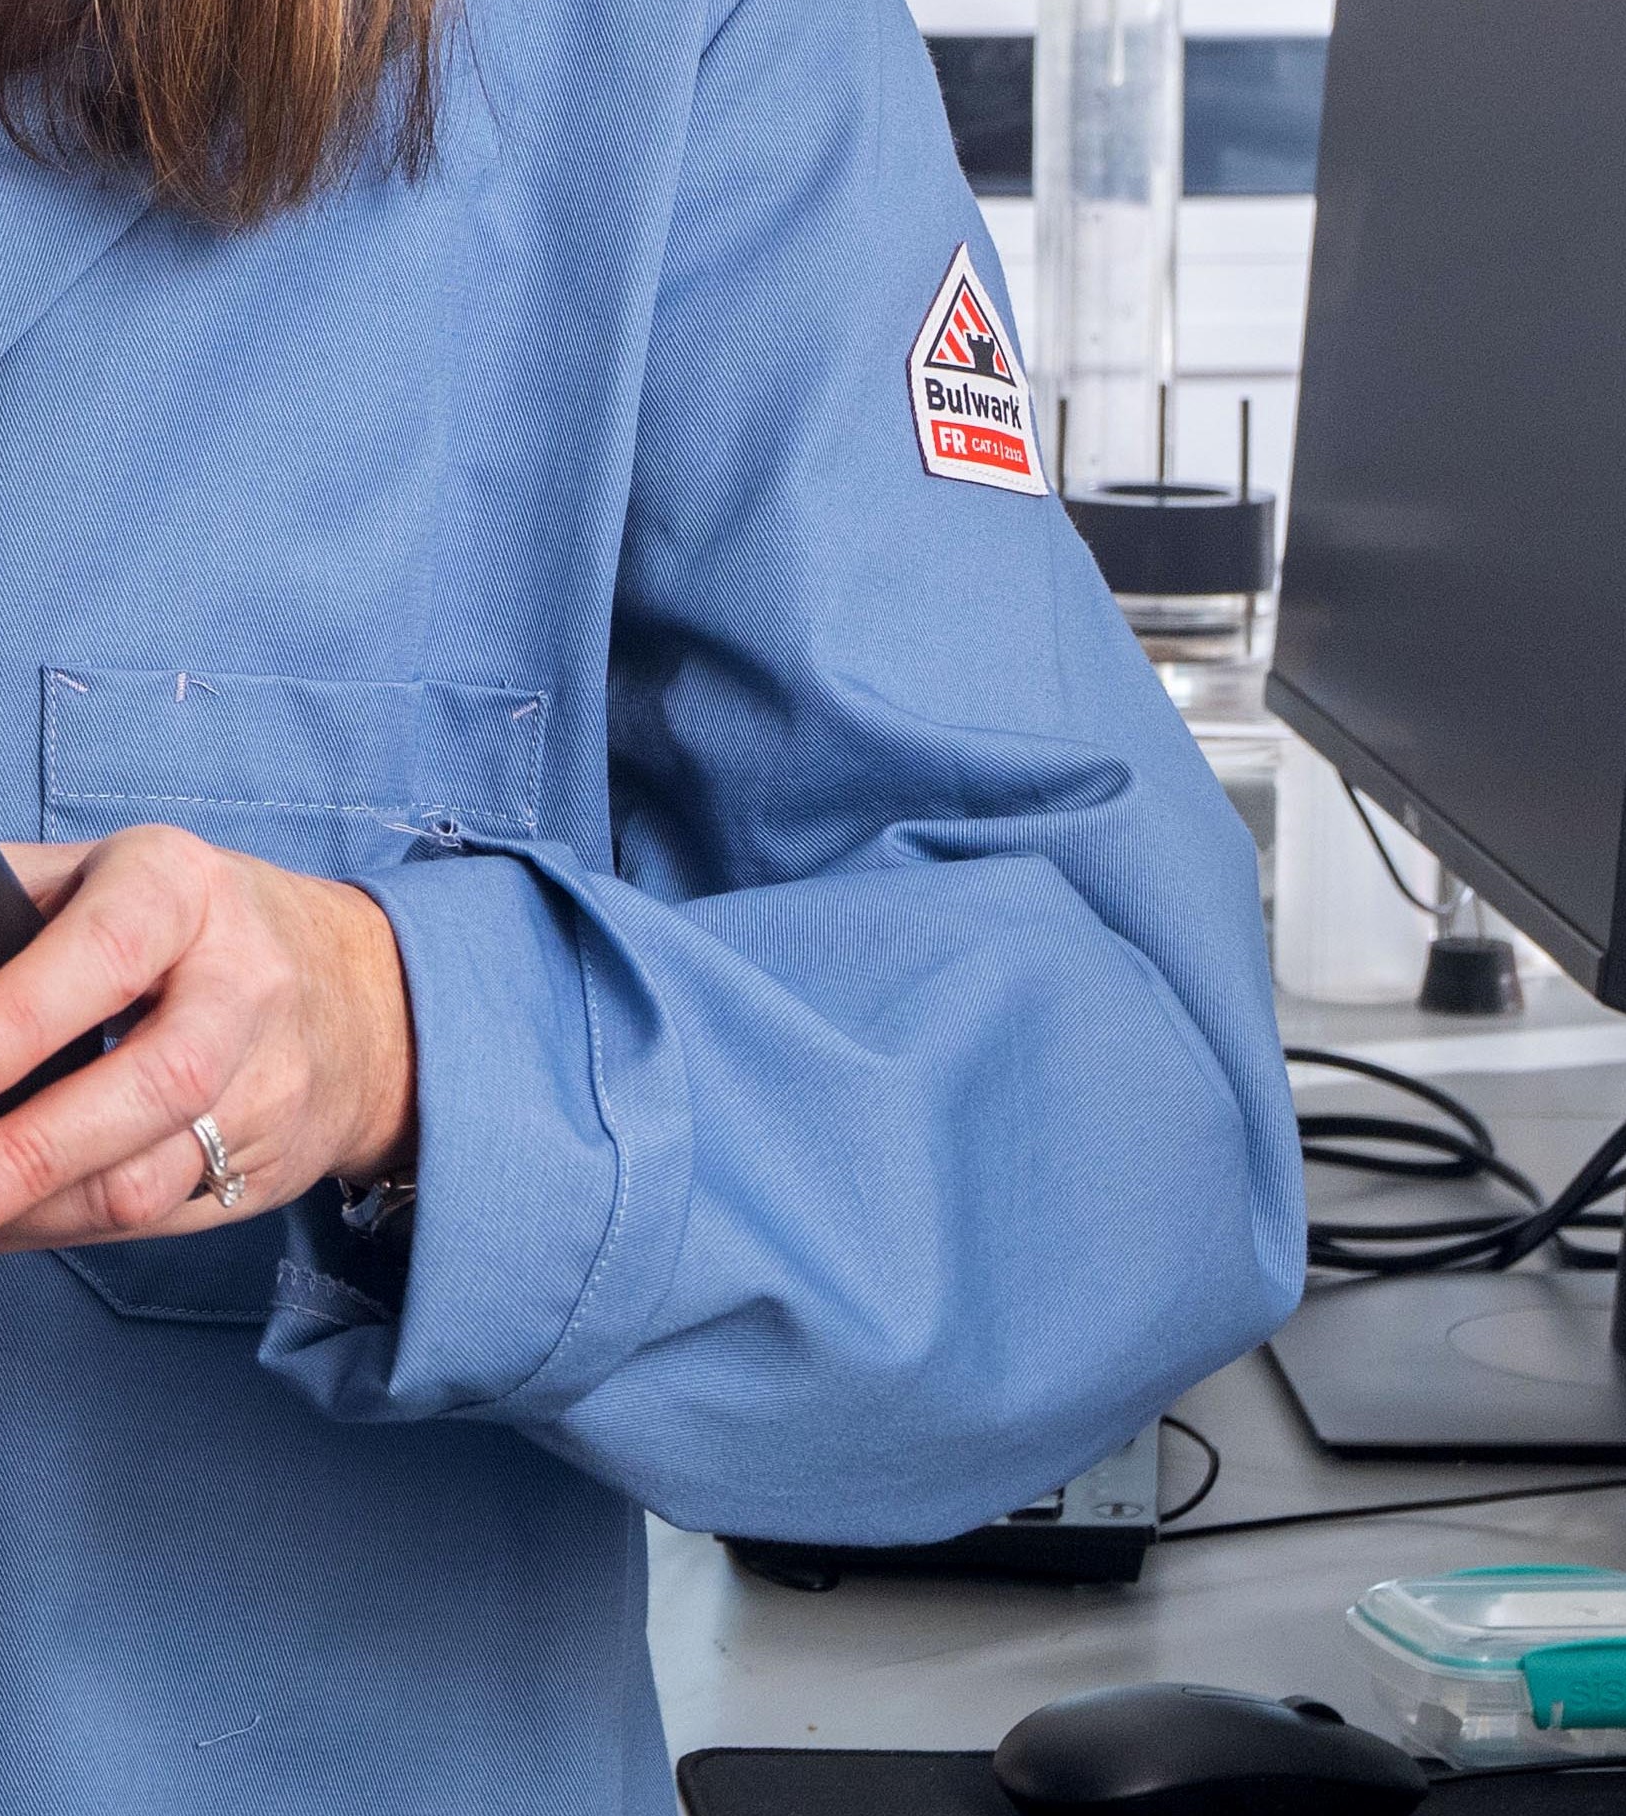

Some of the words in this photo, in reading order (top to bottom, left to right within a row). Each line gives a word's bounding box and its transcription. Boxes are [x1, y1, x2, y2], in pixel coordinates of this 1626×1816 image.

[925, 377, 1022, 430] Bulwark
[938, 426, 968, 455] FR
[972, 438, 993, 453] CAT
